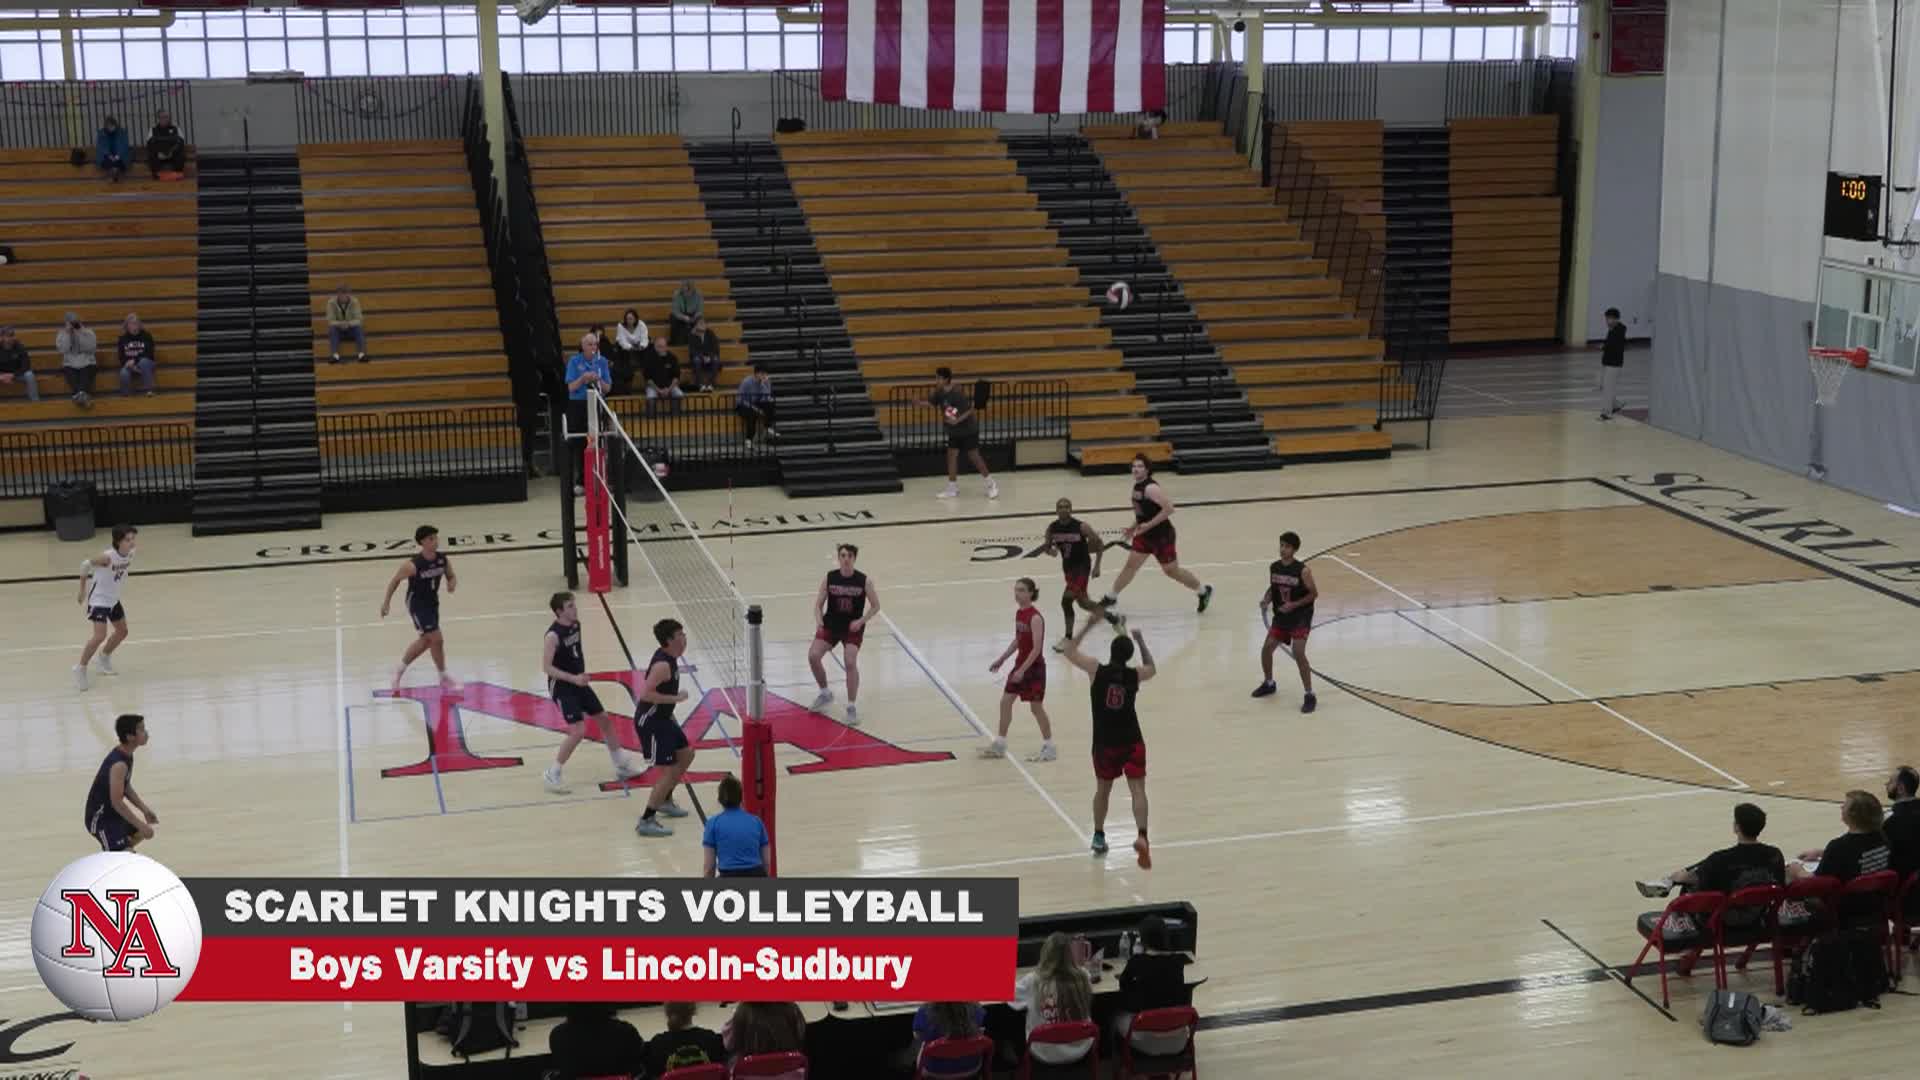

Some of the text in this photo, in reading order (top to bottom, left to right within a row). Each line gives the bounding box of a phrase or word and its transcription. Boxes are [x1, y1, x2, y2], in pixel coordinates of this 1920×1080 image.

[1842, 181, 1866, 200] 1:00
[256, 510, 875, 558] CROZER MNASIUM
